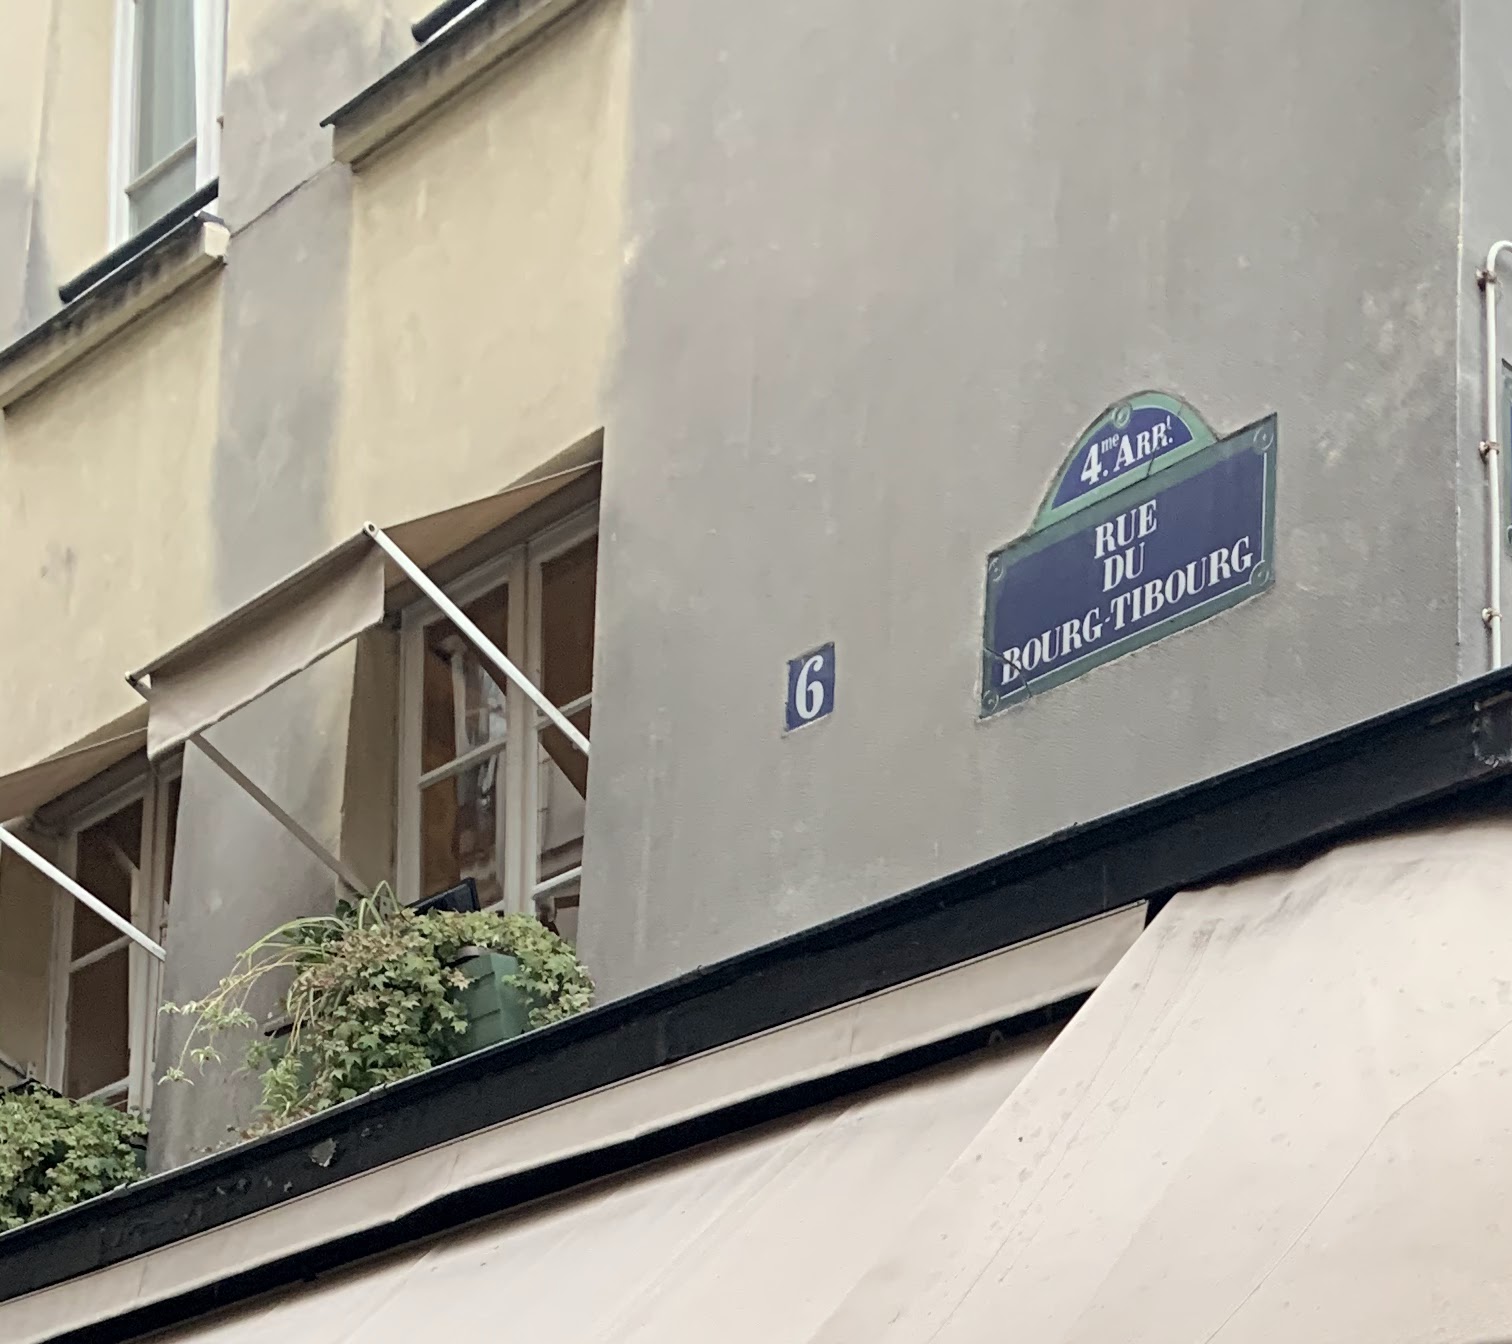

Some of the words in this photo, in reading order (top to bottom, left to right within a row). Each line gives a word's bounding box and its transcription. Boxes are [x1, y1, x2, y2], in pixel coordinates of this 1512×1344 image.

[1094, 499, 1157, 559] RUE
[1103, 542, 1145, 592] DU
[1001, 536, 1254, 685] BOURG-TIBOURG
[795, 655, 824, 719] 6
